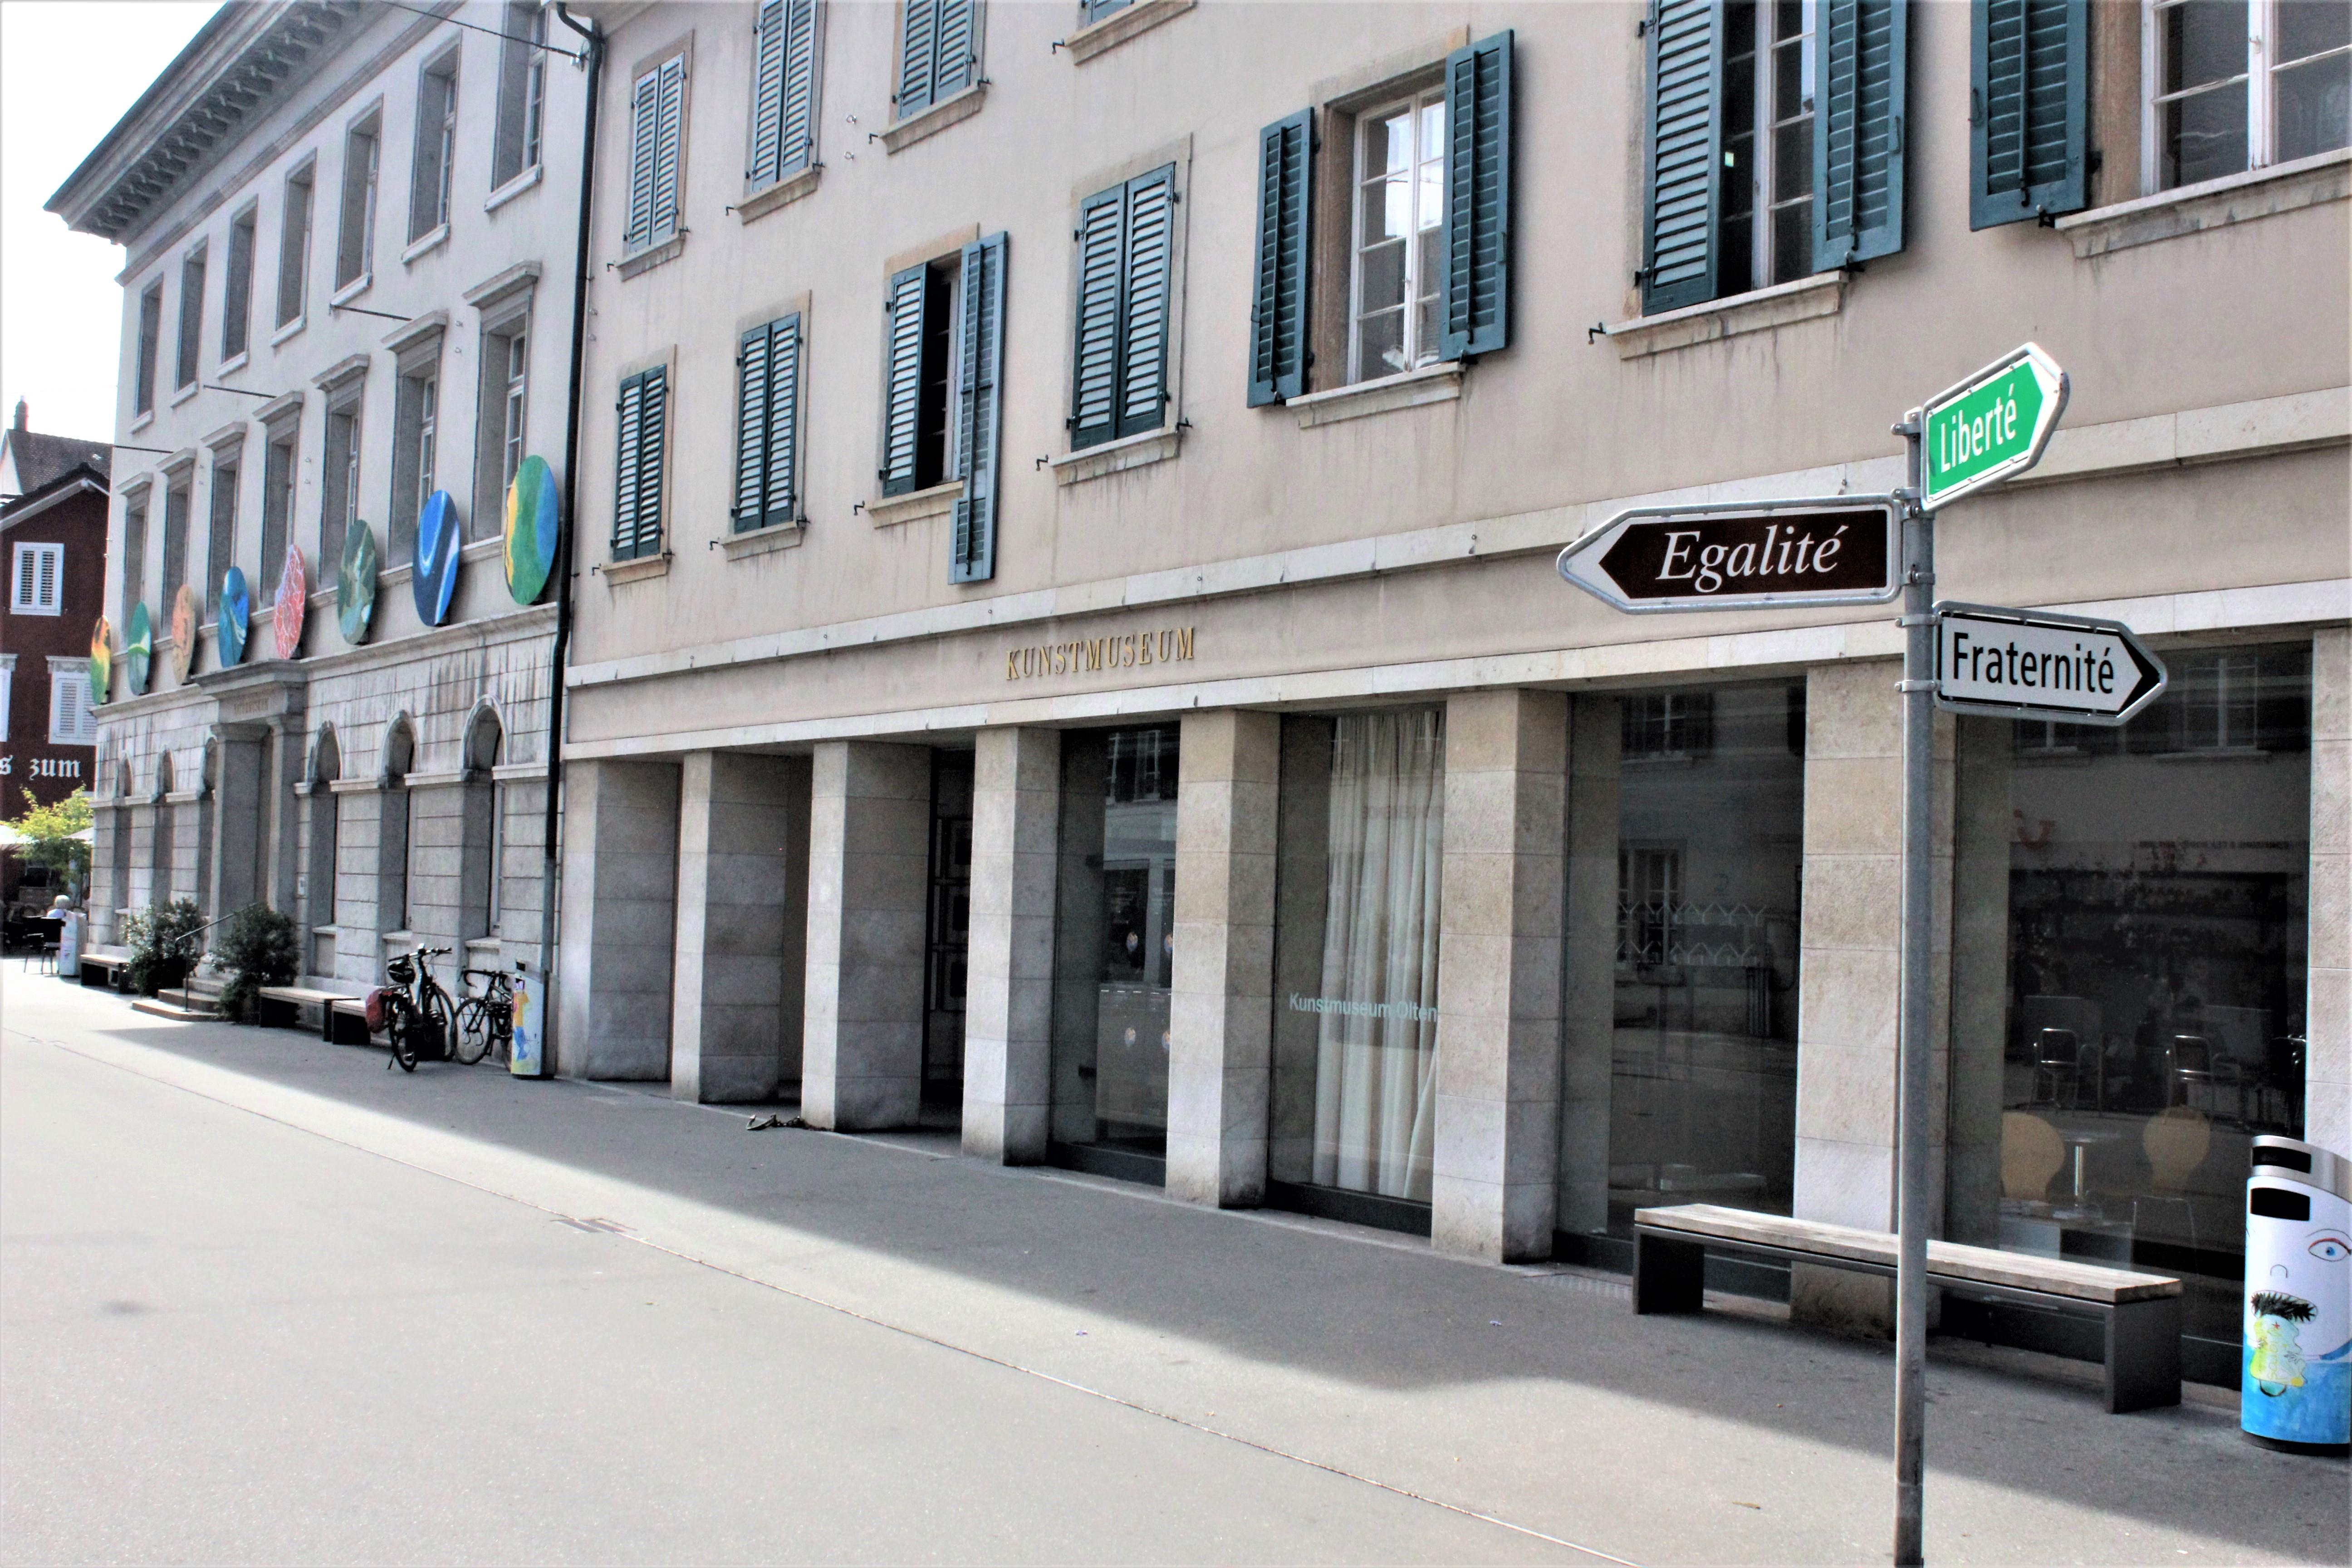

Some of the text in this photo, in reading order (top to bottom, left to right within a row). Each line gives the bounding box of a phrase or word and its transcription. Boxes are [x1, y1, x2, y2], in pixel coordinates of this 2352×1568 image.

[1941, 383, 2017, 472] Liberté
[1656, 524, 1848, 593] Egalité
[1006, 626, 1195, 680] KUNSTMUSEUM
[1954, 632, 2114, 693] Fraternité
[29, 758, 81, 780] zum
[1289, 992, 1438, 1023] Kunstmuseum Olten
